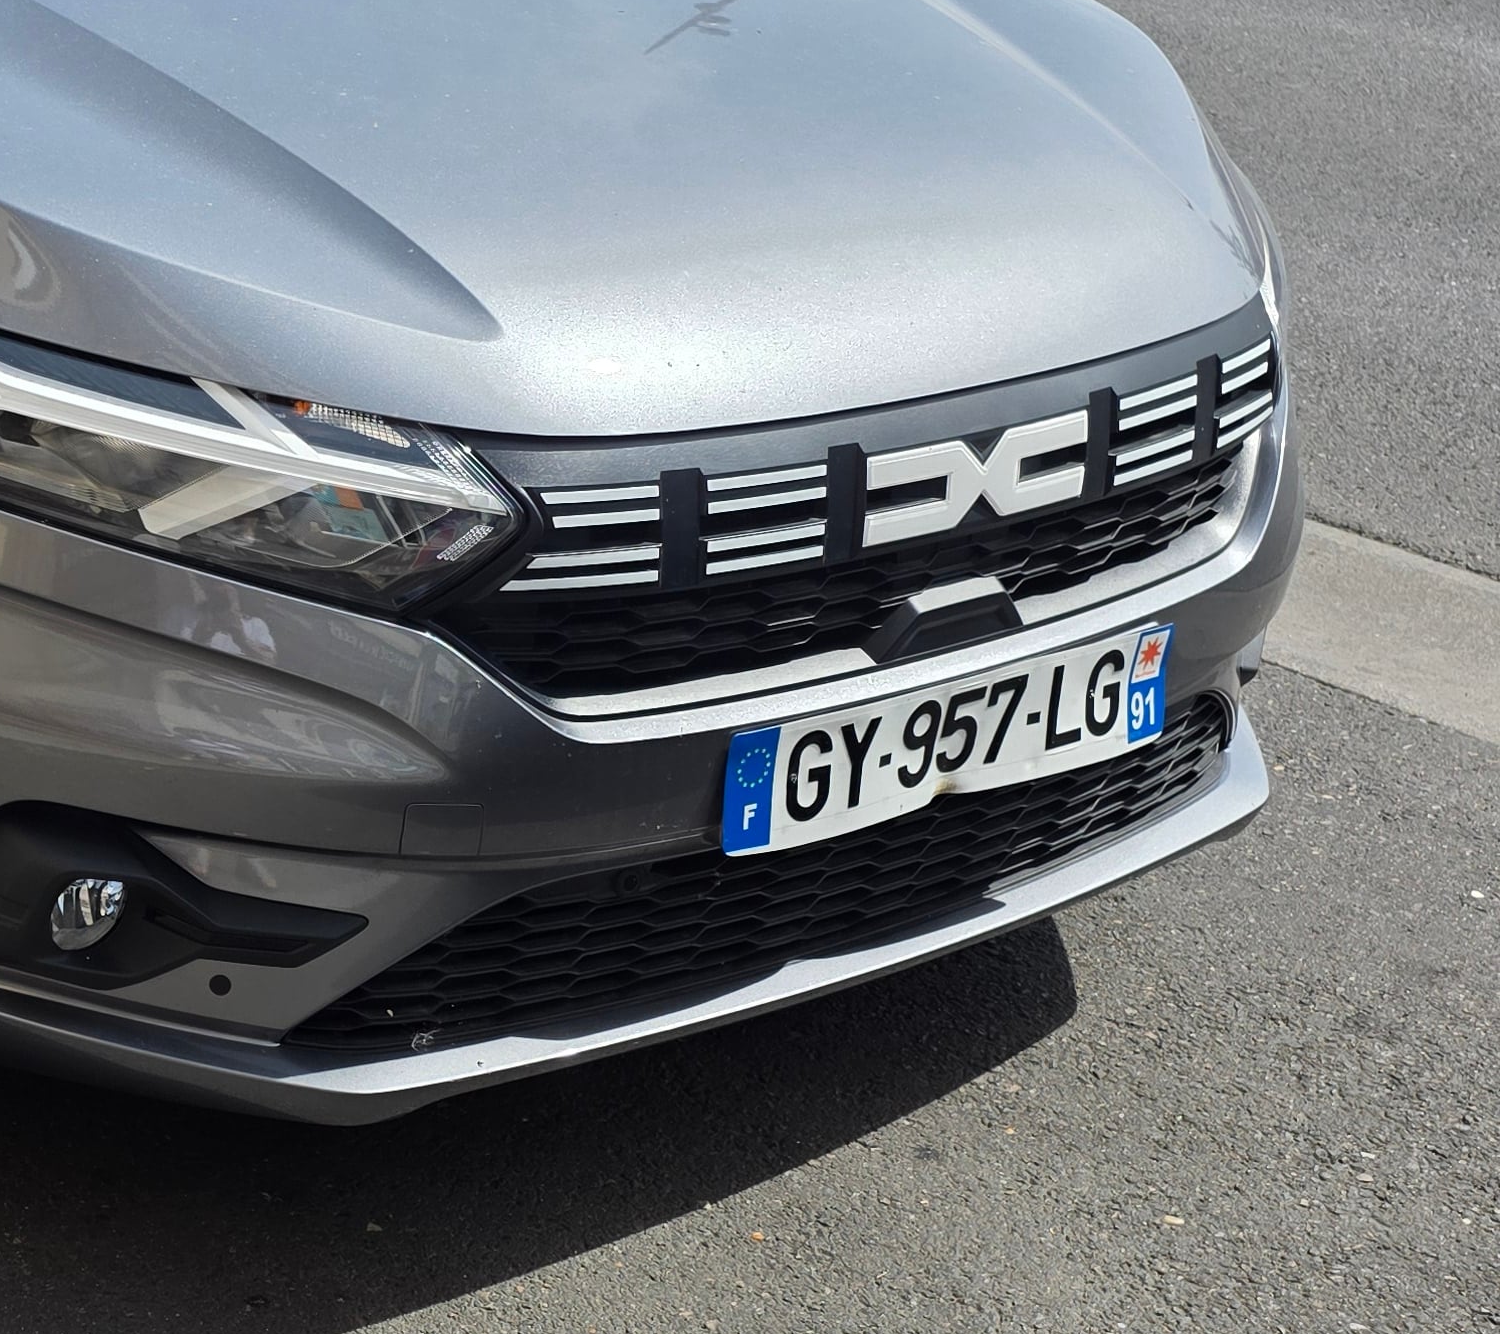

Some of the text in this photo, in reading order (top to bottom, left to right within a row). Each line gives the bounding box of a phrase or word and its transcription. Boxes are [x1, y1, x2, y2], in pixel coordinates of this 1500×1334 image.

[1130, 686, 1155, 731] 91
[784, 649, 1125, 822] GY-957-LG
[742, 803, 758, 831] F
